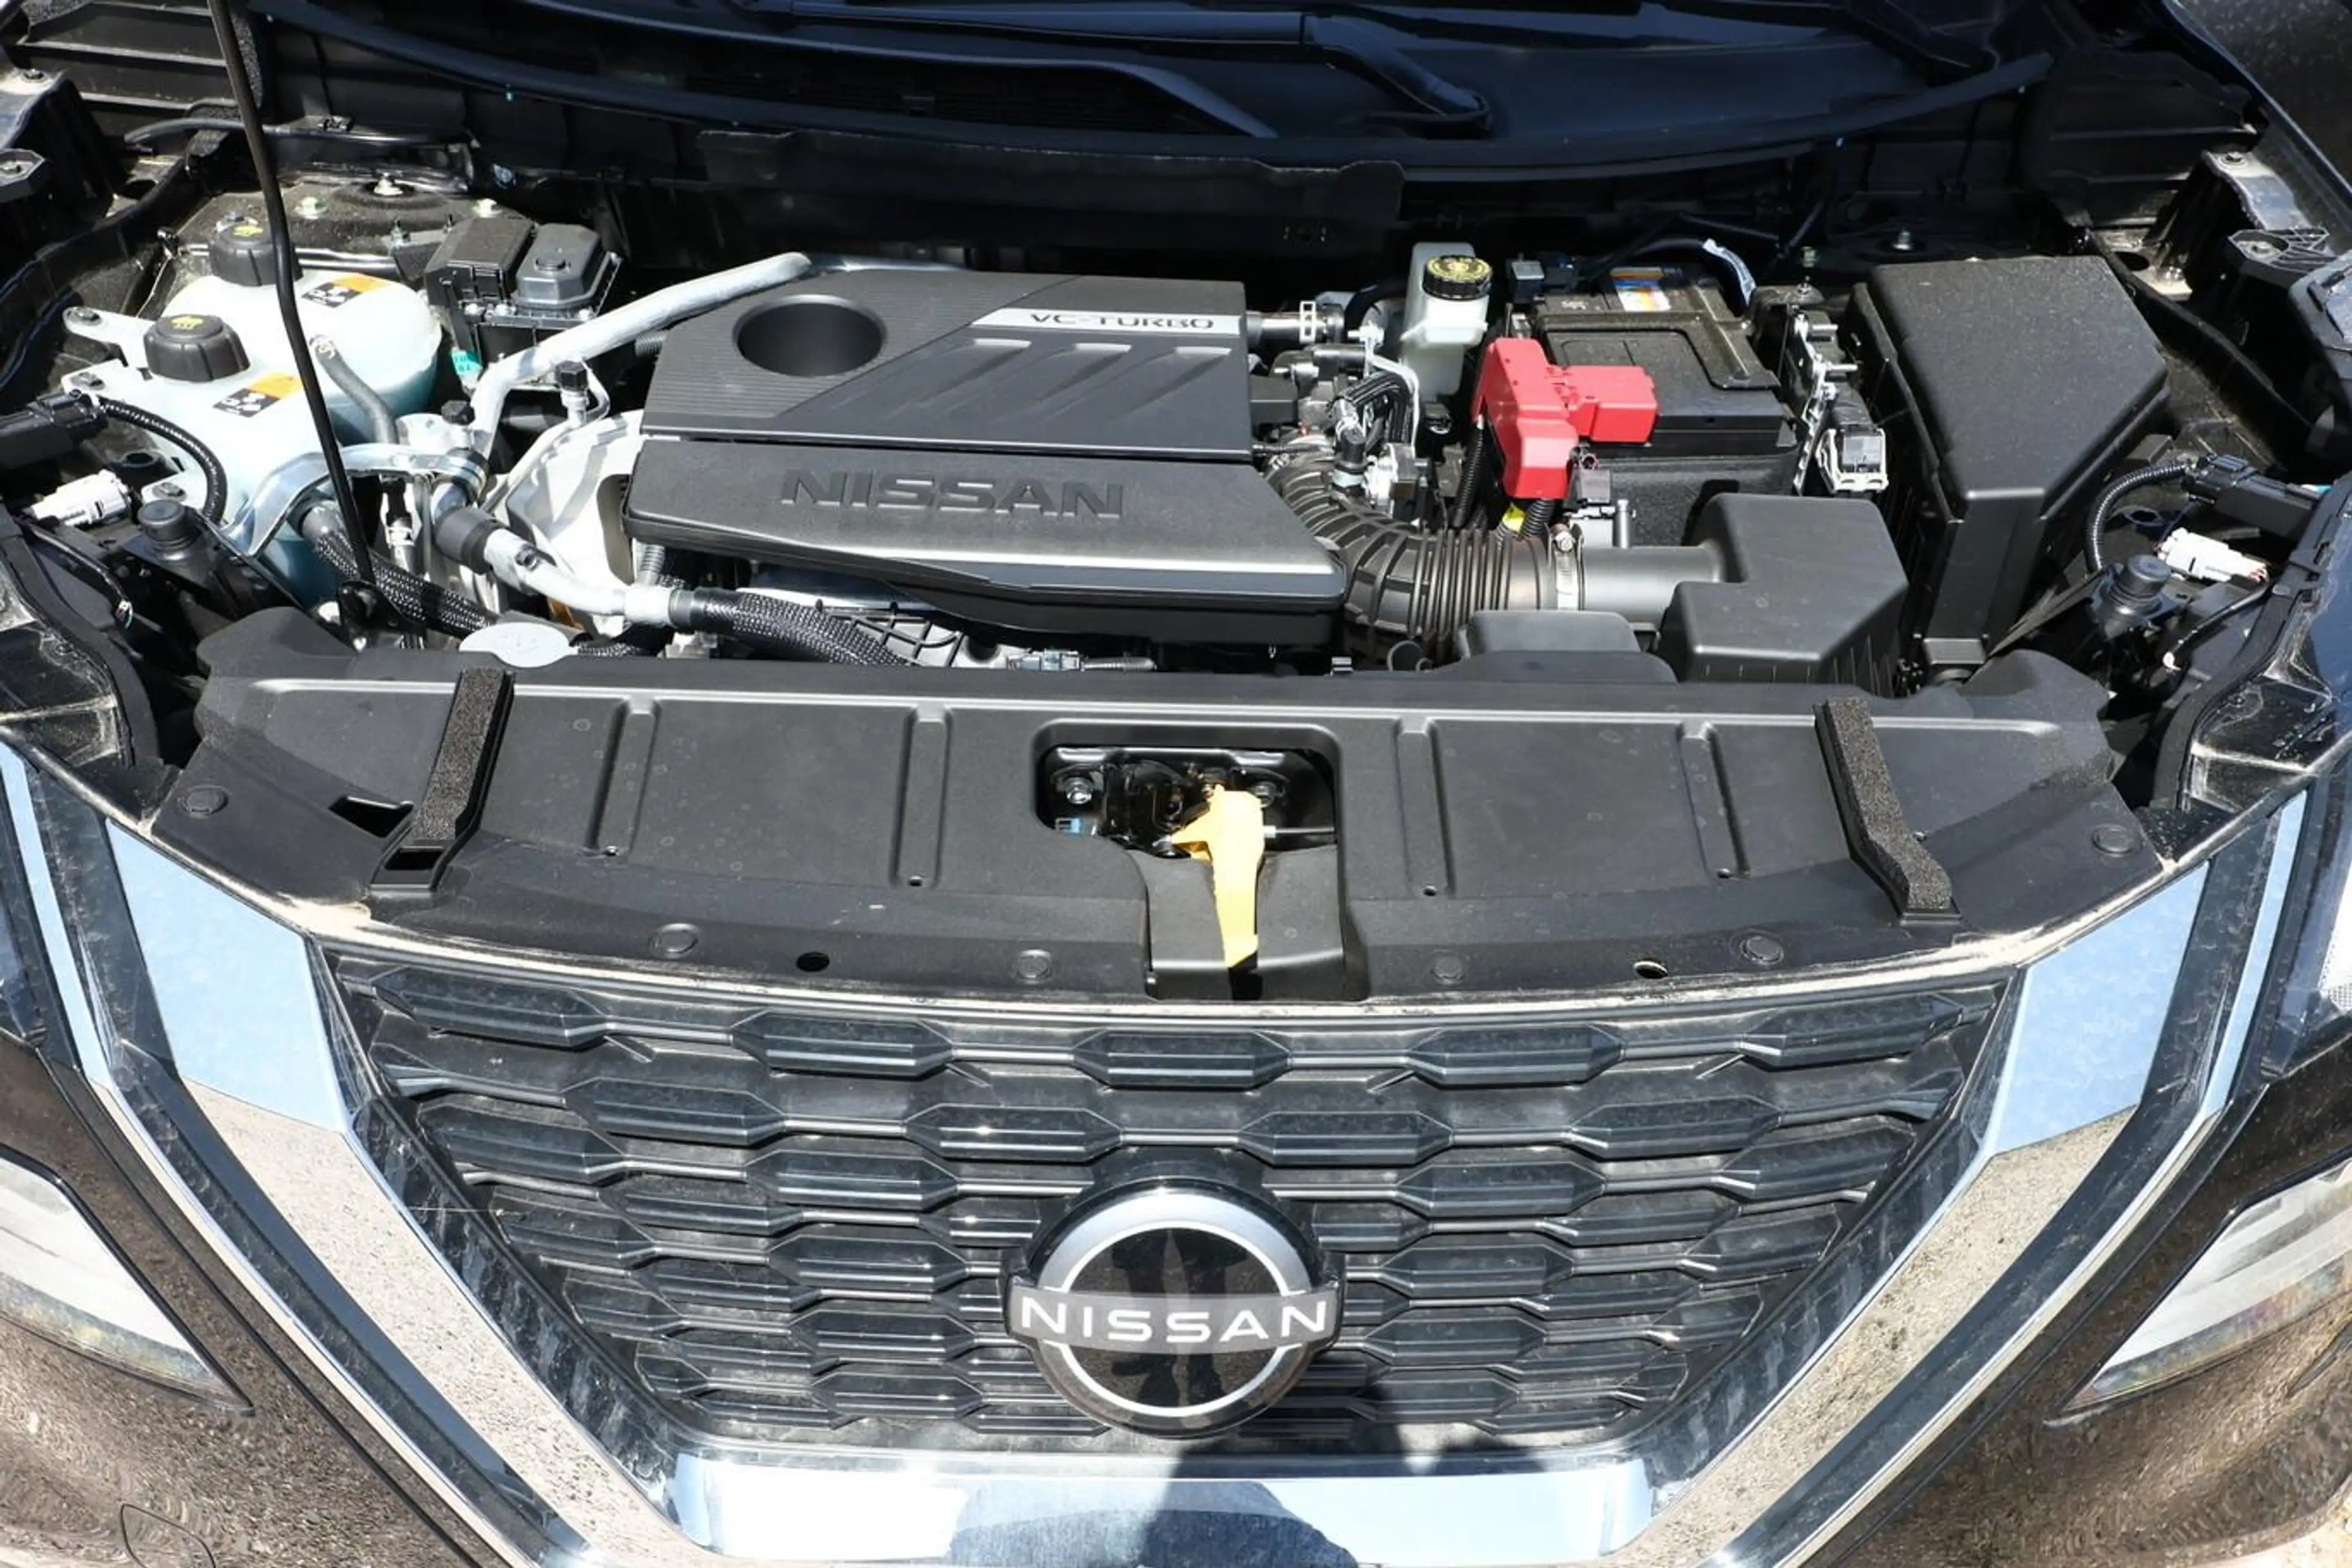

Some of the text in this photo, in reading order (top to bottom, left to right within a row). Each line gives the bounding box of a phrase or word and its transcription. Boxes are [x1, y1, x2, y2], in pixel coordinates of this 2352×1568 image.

[1030, 314, 1215, 329] VC-TURBO
[780, 469, 1125, 518] NISSAN
[1020, 1295, 1327, 1344] NISSAN
